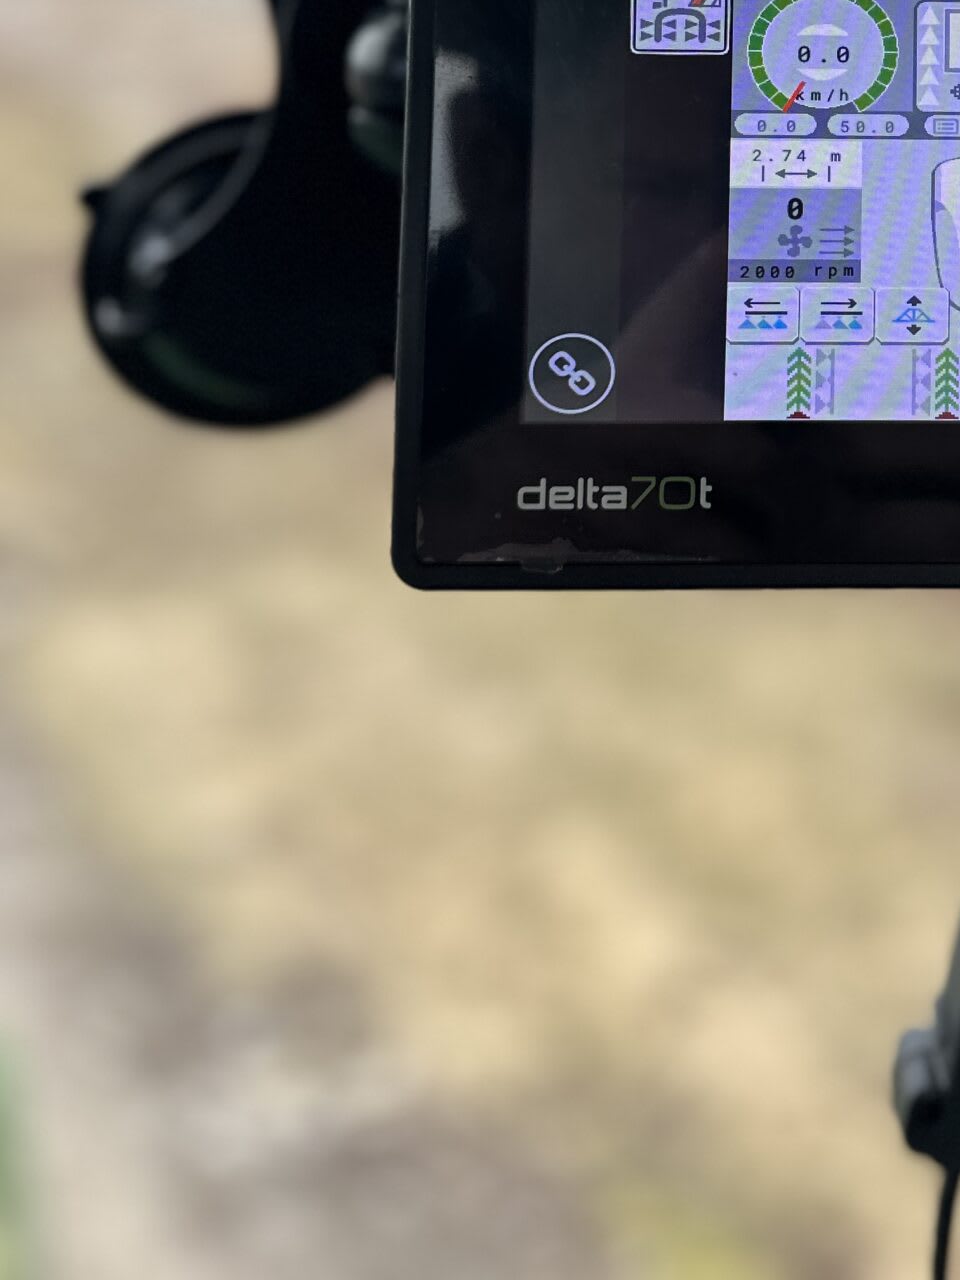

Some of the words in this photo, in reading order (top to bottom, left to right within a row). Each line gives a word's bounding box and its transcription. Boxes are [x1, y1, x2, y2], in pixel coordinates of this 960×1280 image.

[798, 46, 850, 63] 0.0
[757, 120, 796, 133] 0.0
[840, 121, 895, 134] 50.0
[752, 149, 807, 163] 2.74
[830, 151, 842, 162] m
[787, 197, 804, 220] 0
[740, 265, 796, 279] 2000
[815, 264, 854, 280] rpm
[517, 476, 713, 510] delta70t
